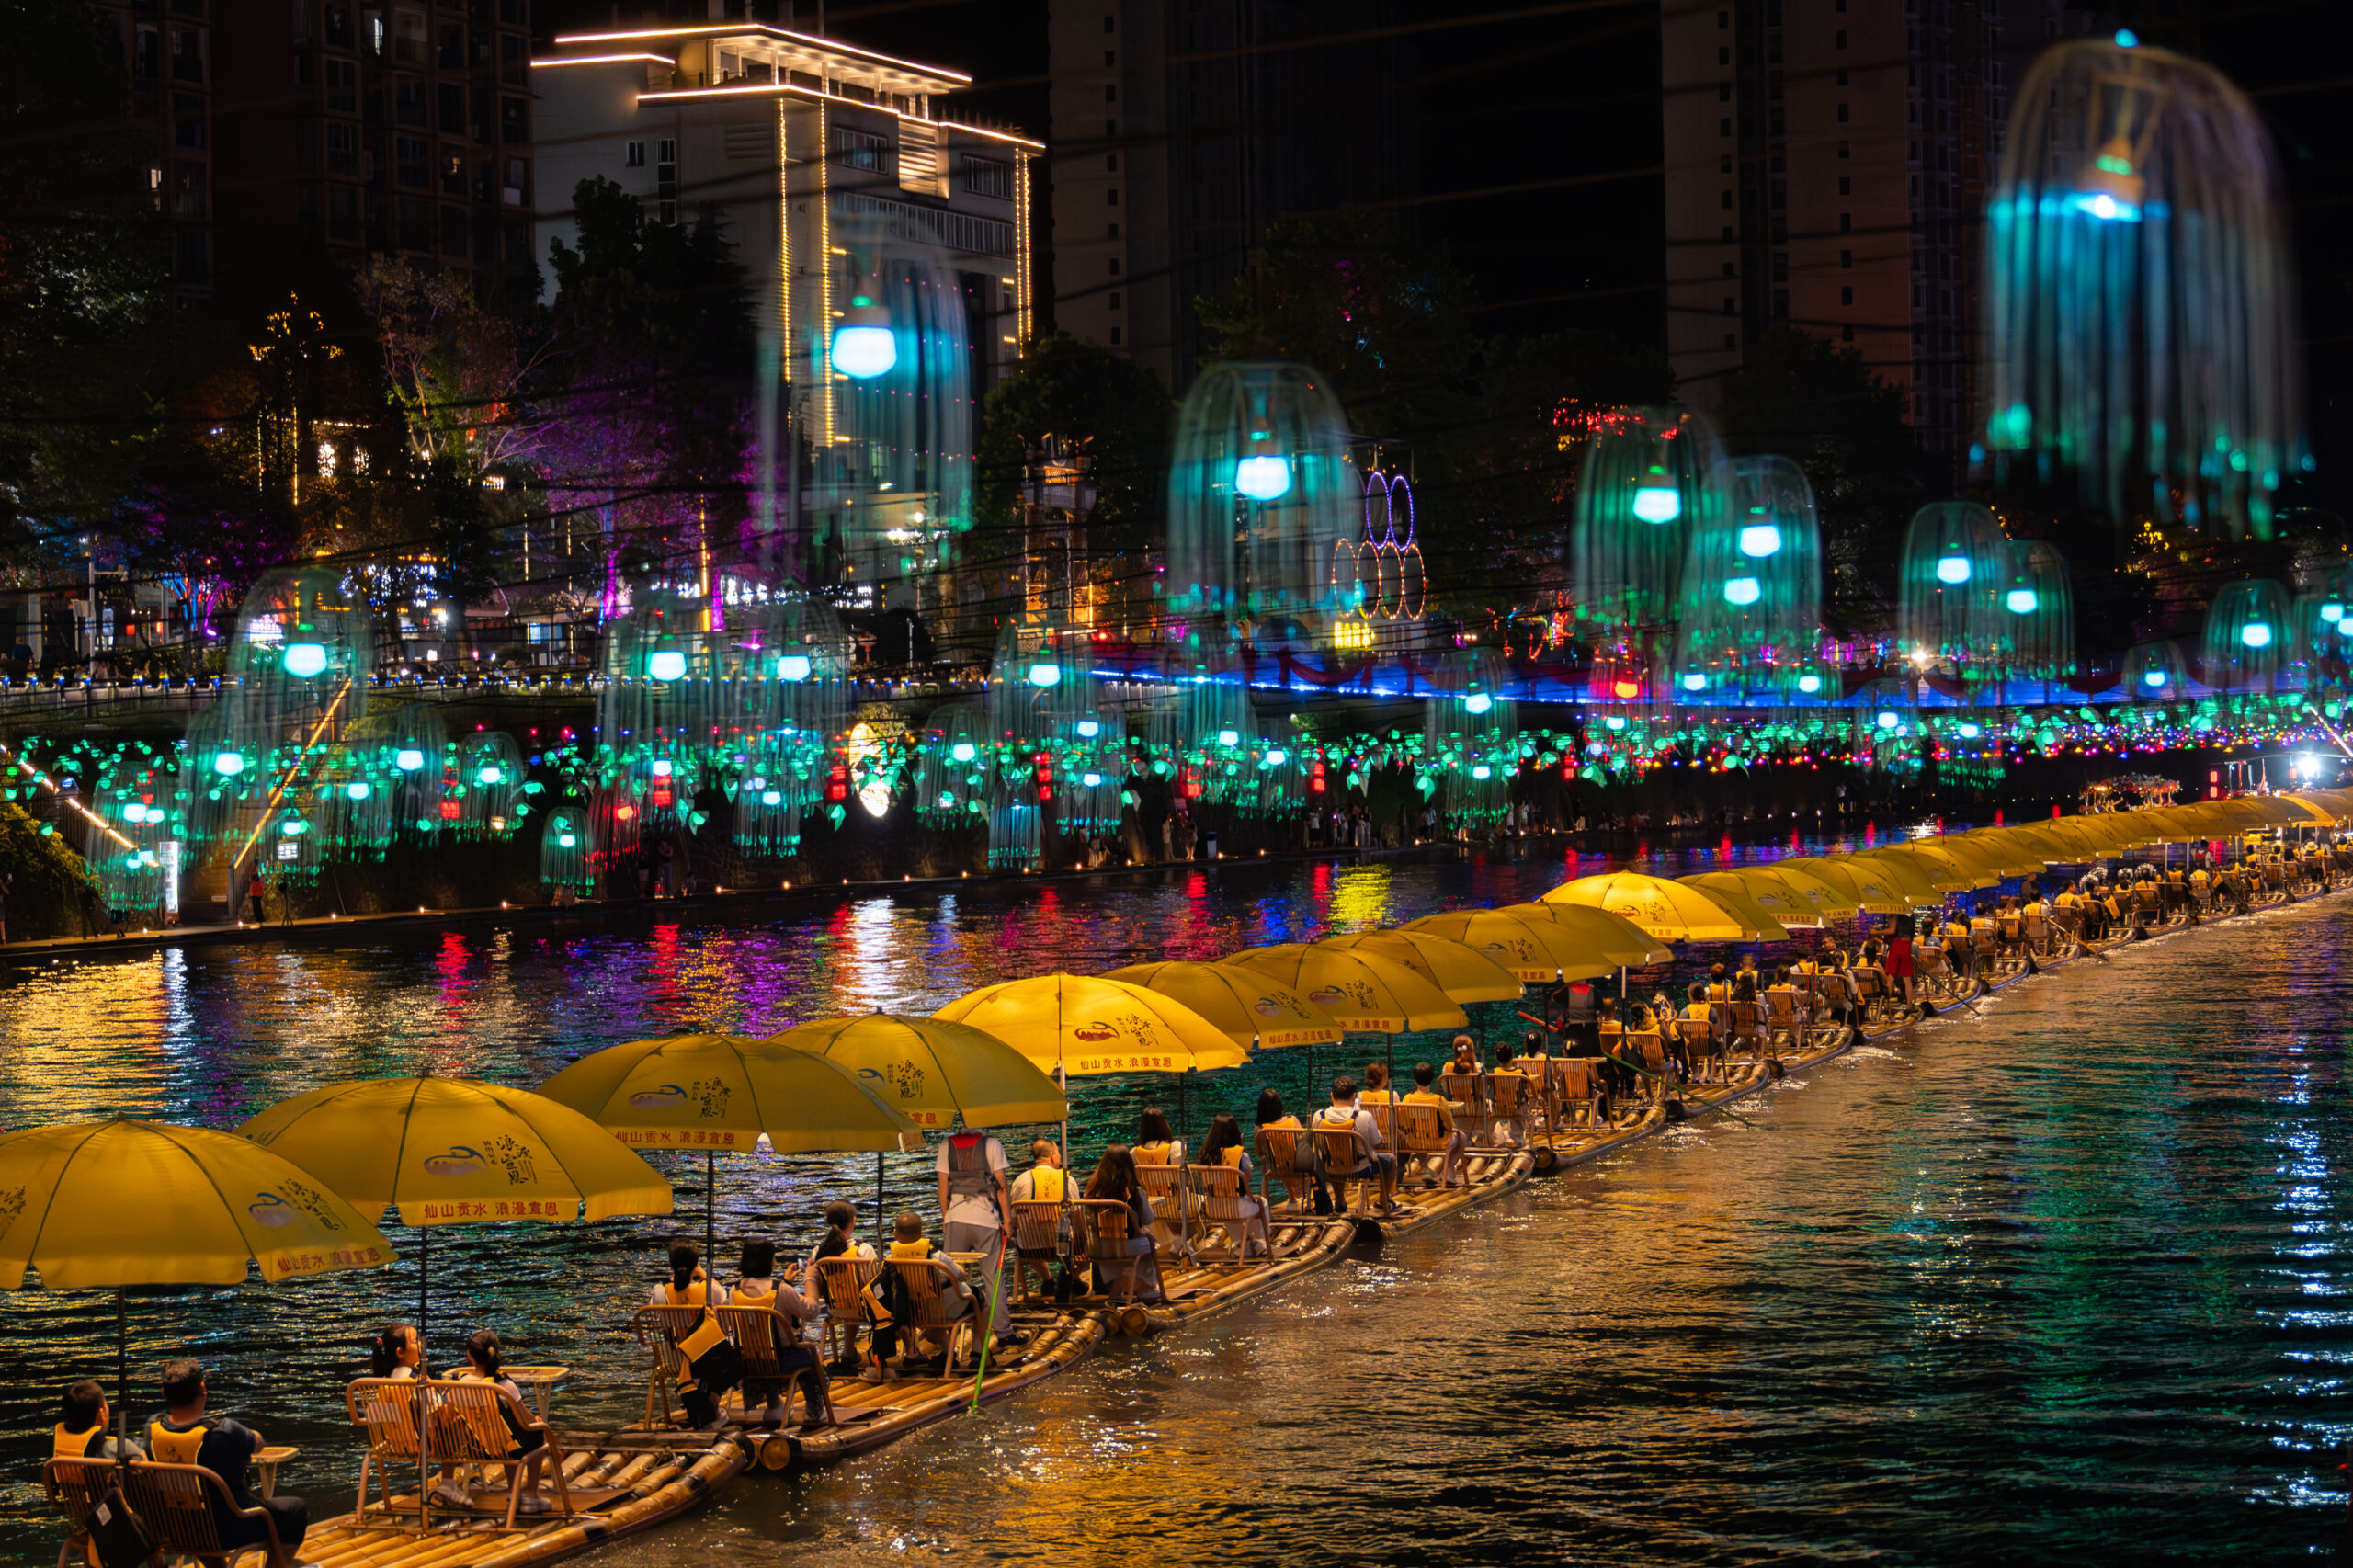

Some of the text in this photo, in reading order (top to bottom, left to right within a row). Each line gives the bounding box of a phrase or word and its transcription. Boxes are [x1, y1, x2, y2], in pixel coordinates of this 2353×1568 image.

[1080, 1056, 1172, 1070] 仙山贡水 浪漫宣恩
[616, 1131, 735, 1145] 仙山贡水 浪漫宣恩
[425, 1201, 559, 1219] 仙山贡水 浪漫宣恩
